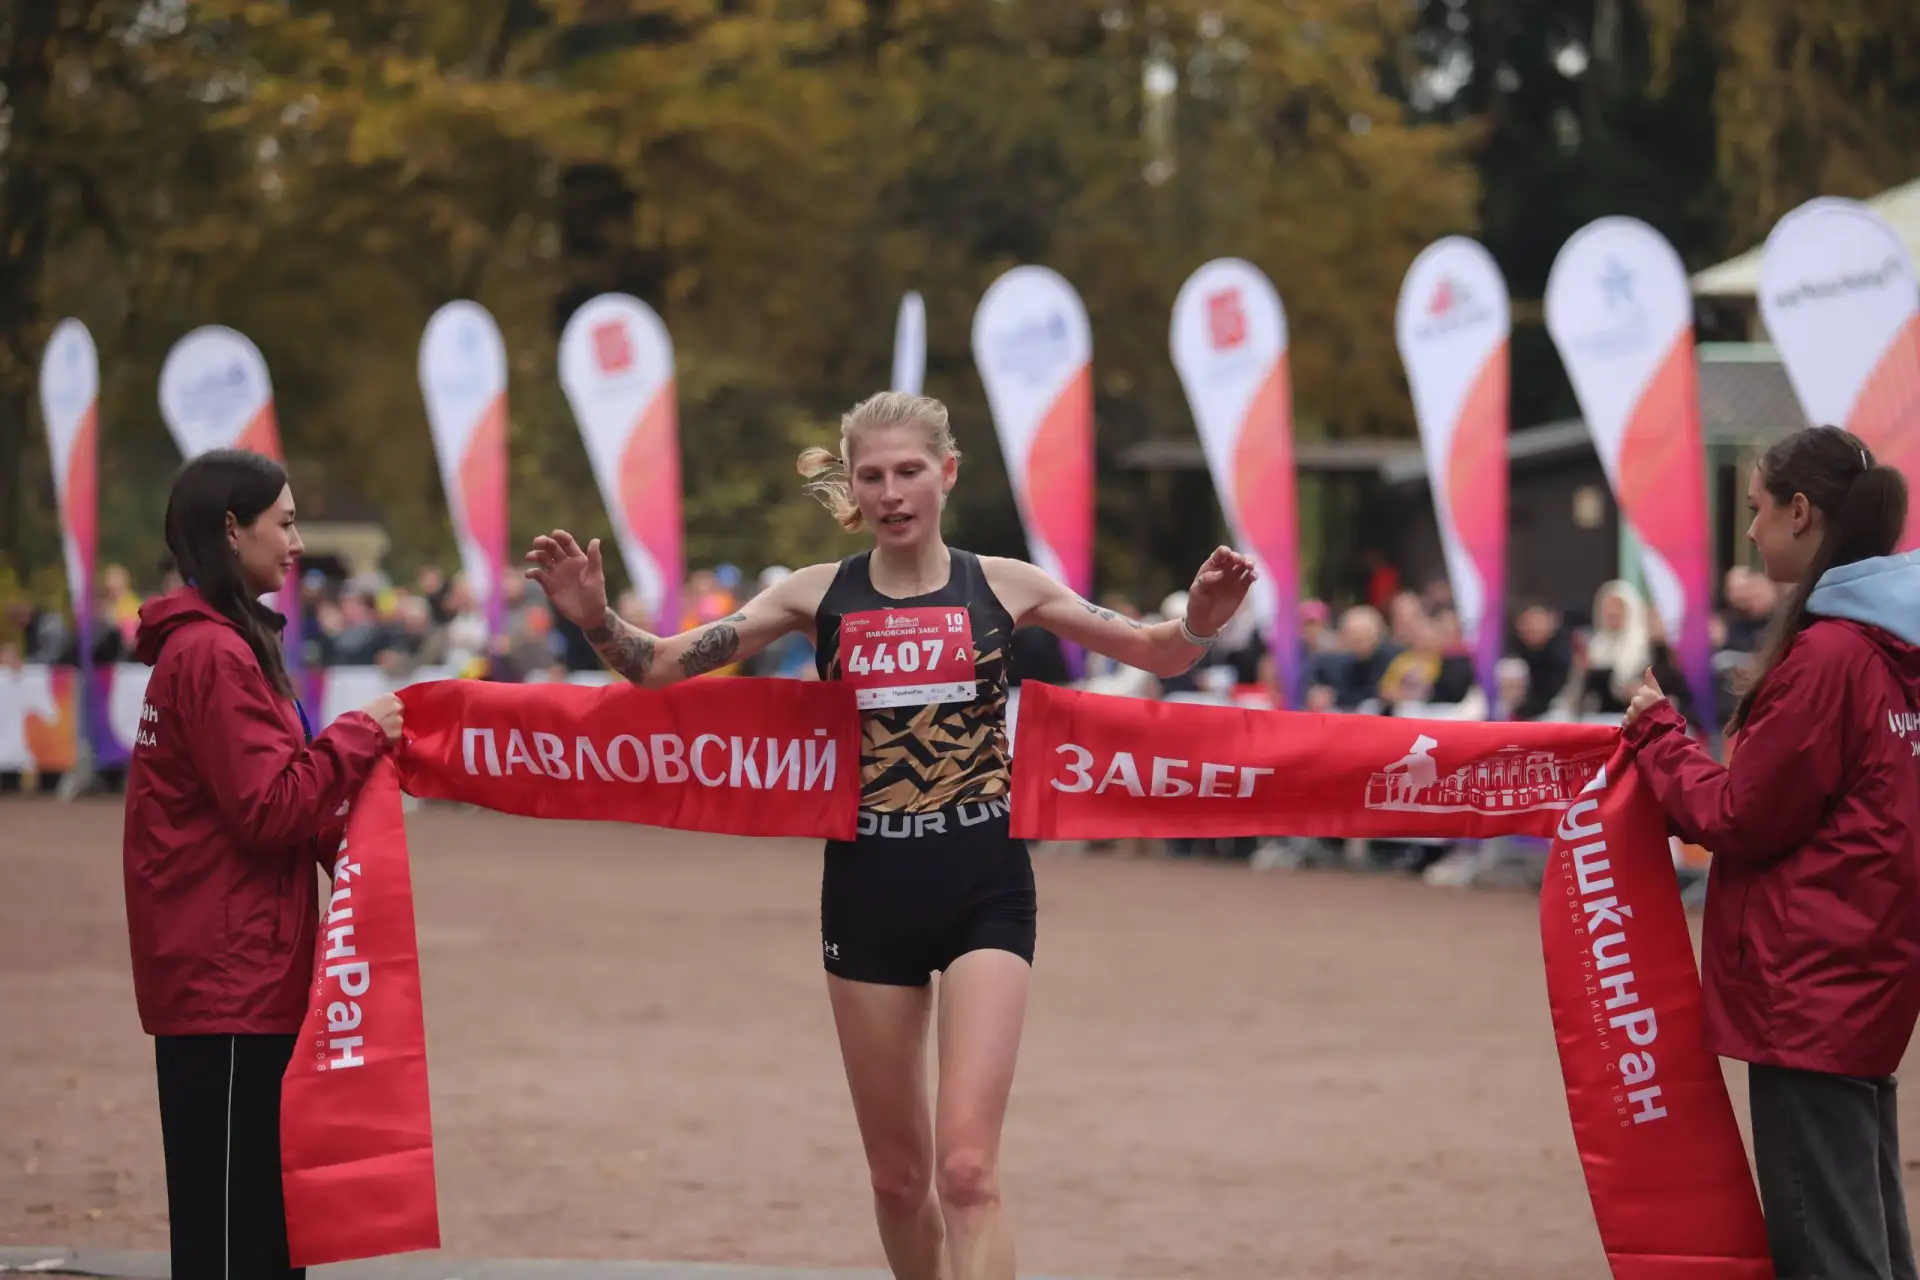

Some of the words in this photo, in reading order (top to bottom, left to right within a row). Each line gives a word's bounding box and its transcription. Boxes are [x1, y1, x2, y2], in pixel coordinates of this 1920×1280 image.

[866, 627, 916, 638] ПАВЛОВСКИЙ
[918, 626, 940, 634] ЗАБЕГ
[945, 613, 964, 626] 10
[848, 639, 944, 676] 4407
[462, 727, 837, 791] ПАВЛОВСКИЙ
[1050, 743, 1275, 797] ЗАБЕГ
[1559, 849, 1585, 937] БЕГОВЫЕ
[1579, 947, 1610, 1051] ТРАДИЦИИ
[1611, 1084, 1630, 1129] 1888
[314, 1029, 327, 1073] 1888
